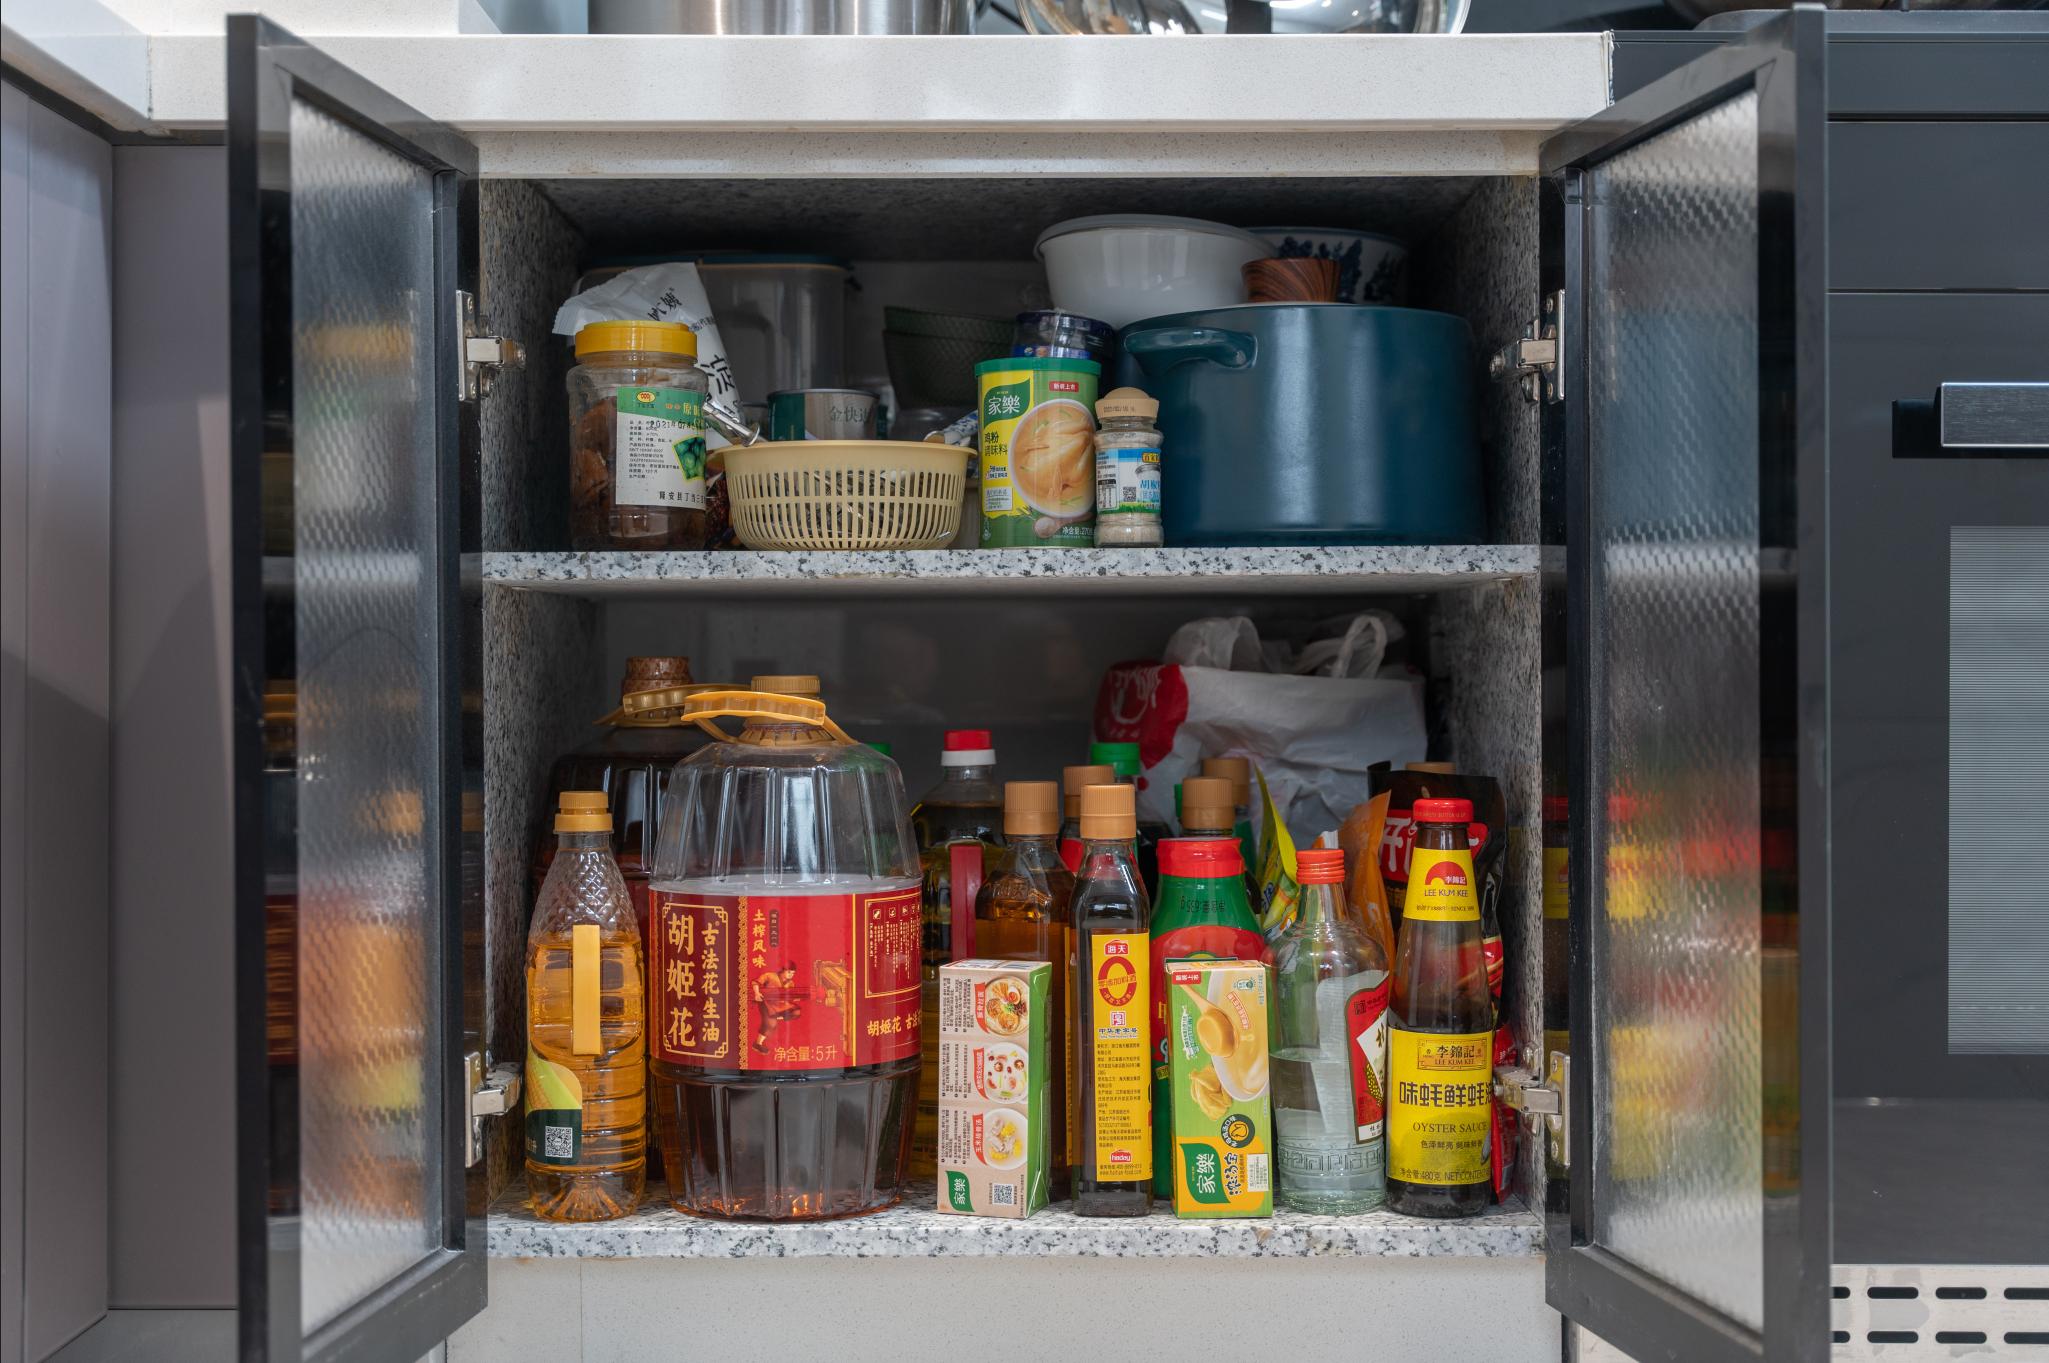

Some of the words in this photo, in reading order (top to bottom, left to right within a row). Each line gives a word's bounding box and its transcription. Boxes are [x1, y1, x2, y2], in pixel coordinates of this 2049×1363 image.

[988, 395, 1020, 416] 家樂
[1424, 889, 1437, 897] LEE
[1438, 889, 1455, 897] KUM
[1457, 889, 1468, 898] KEE
[752, 908, 767, 969] 土榨风味
[1107, 945, 1127, 954] 海天
[666, 912, 697, 1047] 胡姬花
[701, 922, 721, 1043] 古法花生油
[867, 1016, 902, 1037] 胡姬花
[1436, 1045, 1475, 1059] 李錦記
[1413, 1122, 1457, 1133] OYSTER
[1459, 1121, 1487, 1133] SAUCE
[1195, 1153, 1216, 1194] 家樂
[1223, 1152, 1242, 1197] 浓汤宝
[953, 1178, 966, 1205] 家樂
